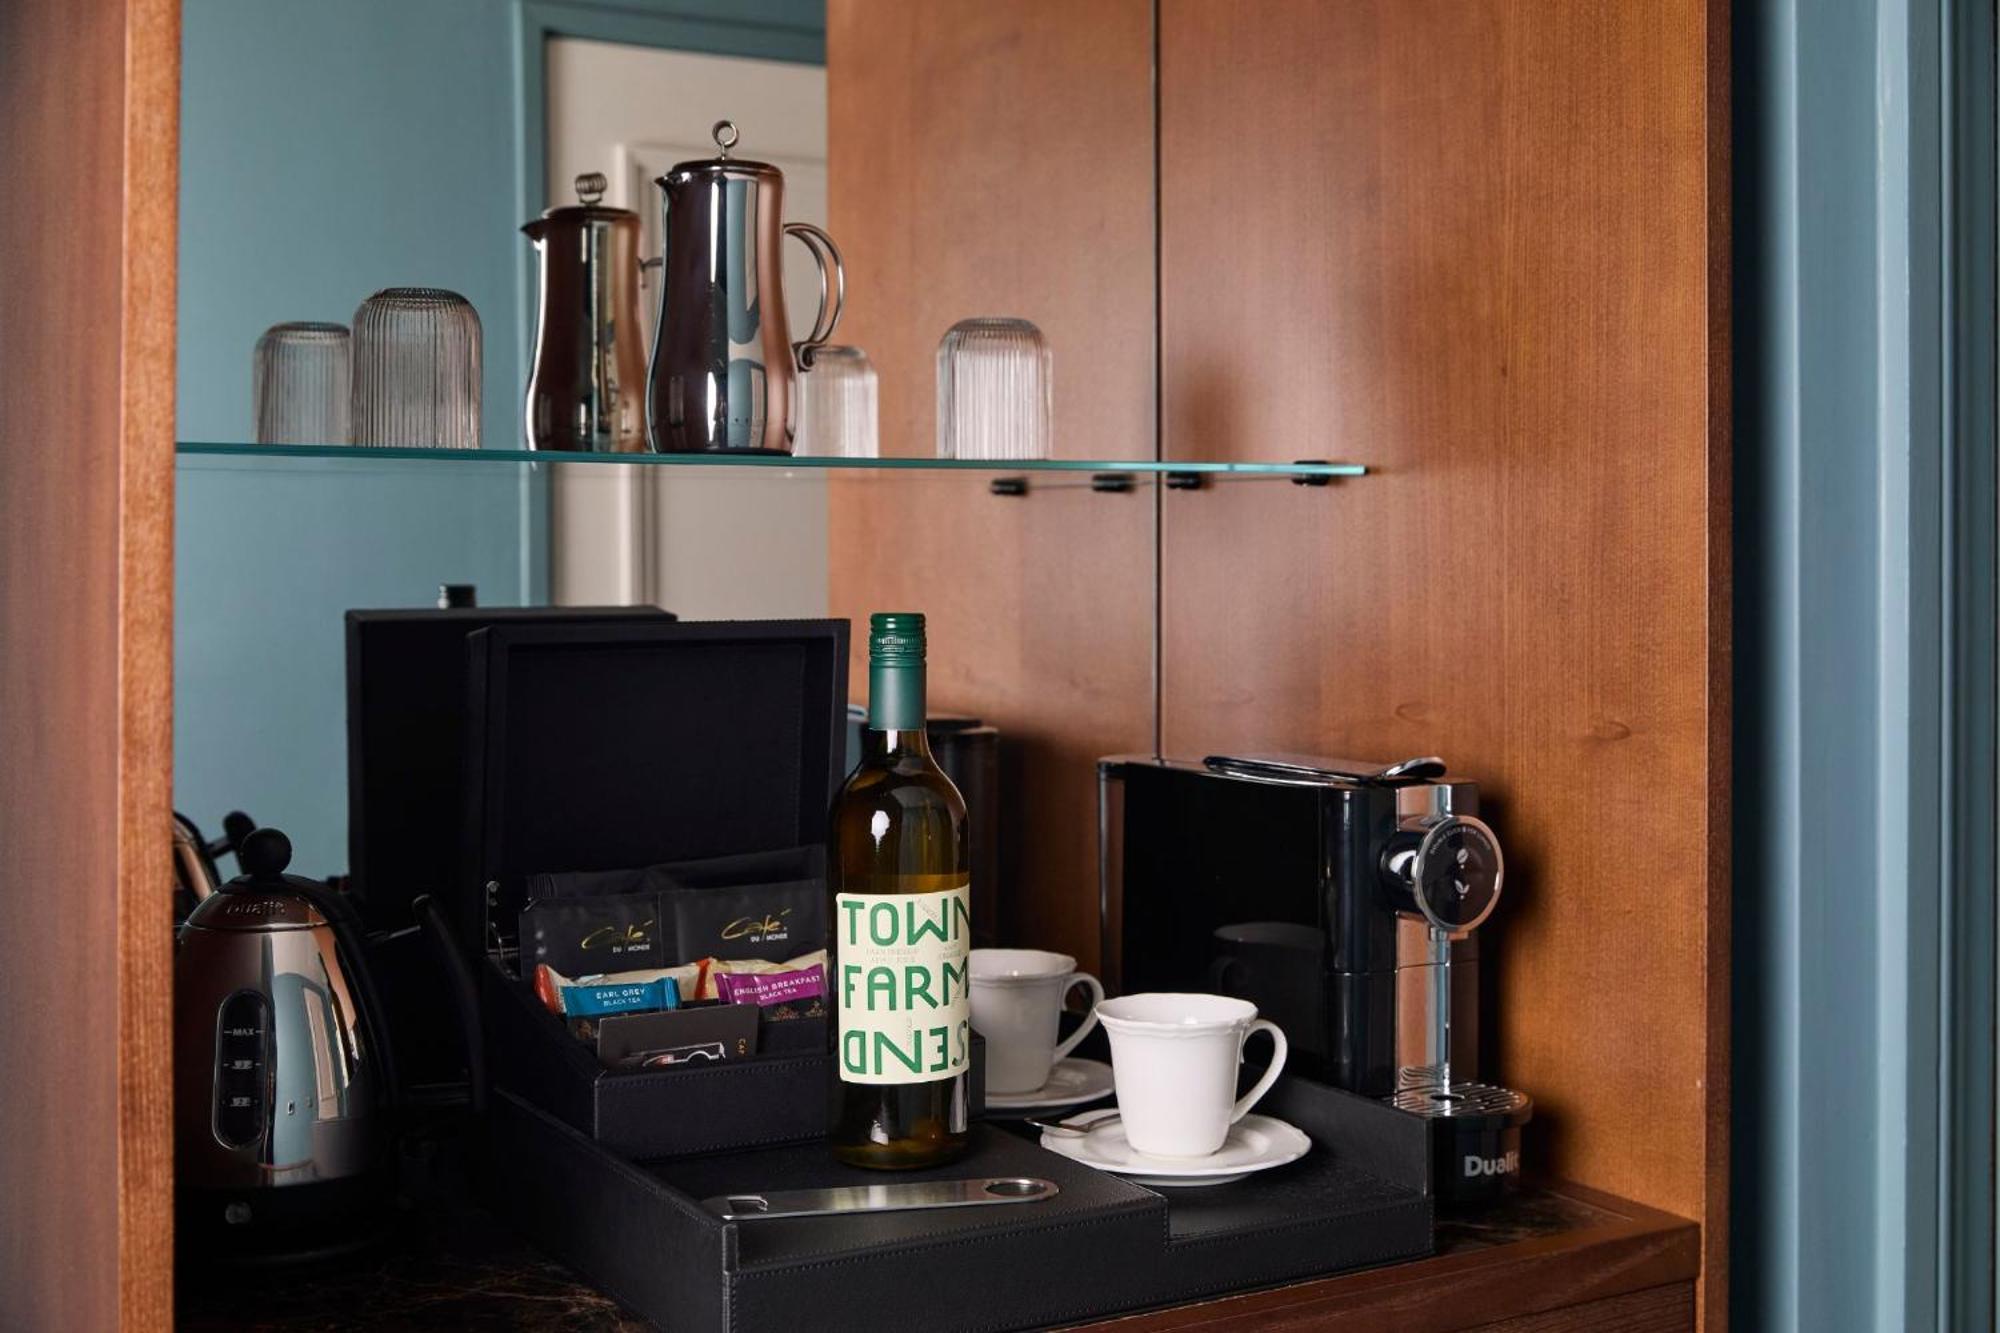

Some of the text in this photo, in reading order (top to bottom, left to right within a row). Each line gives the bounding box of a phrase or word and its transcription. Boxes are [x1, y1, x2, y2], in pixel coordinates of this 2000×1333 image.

[842, 896, 969, 946] TOWN
[734, 975, 820, 996] ENGLISH BREAKFAST
[844, 957, 969, 1010] FARM
[596, 988, 645, 1000] EARL GREY
[760, 990, 782, 1001] BLACK
[232, 1028, 255, 1037] MAX
